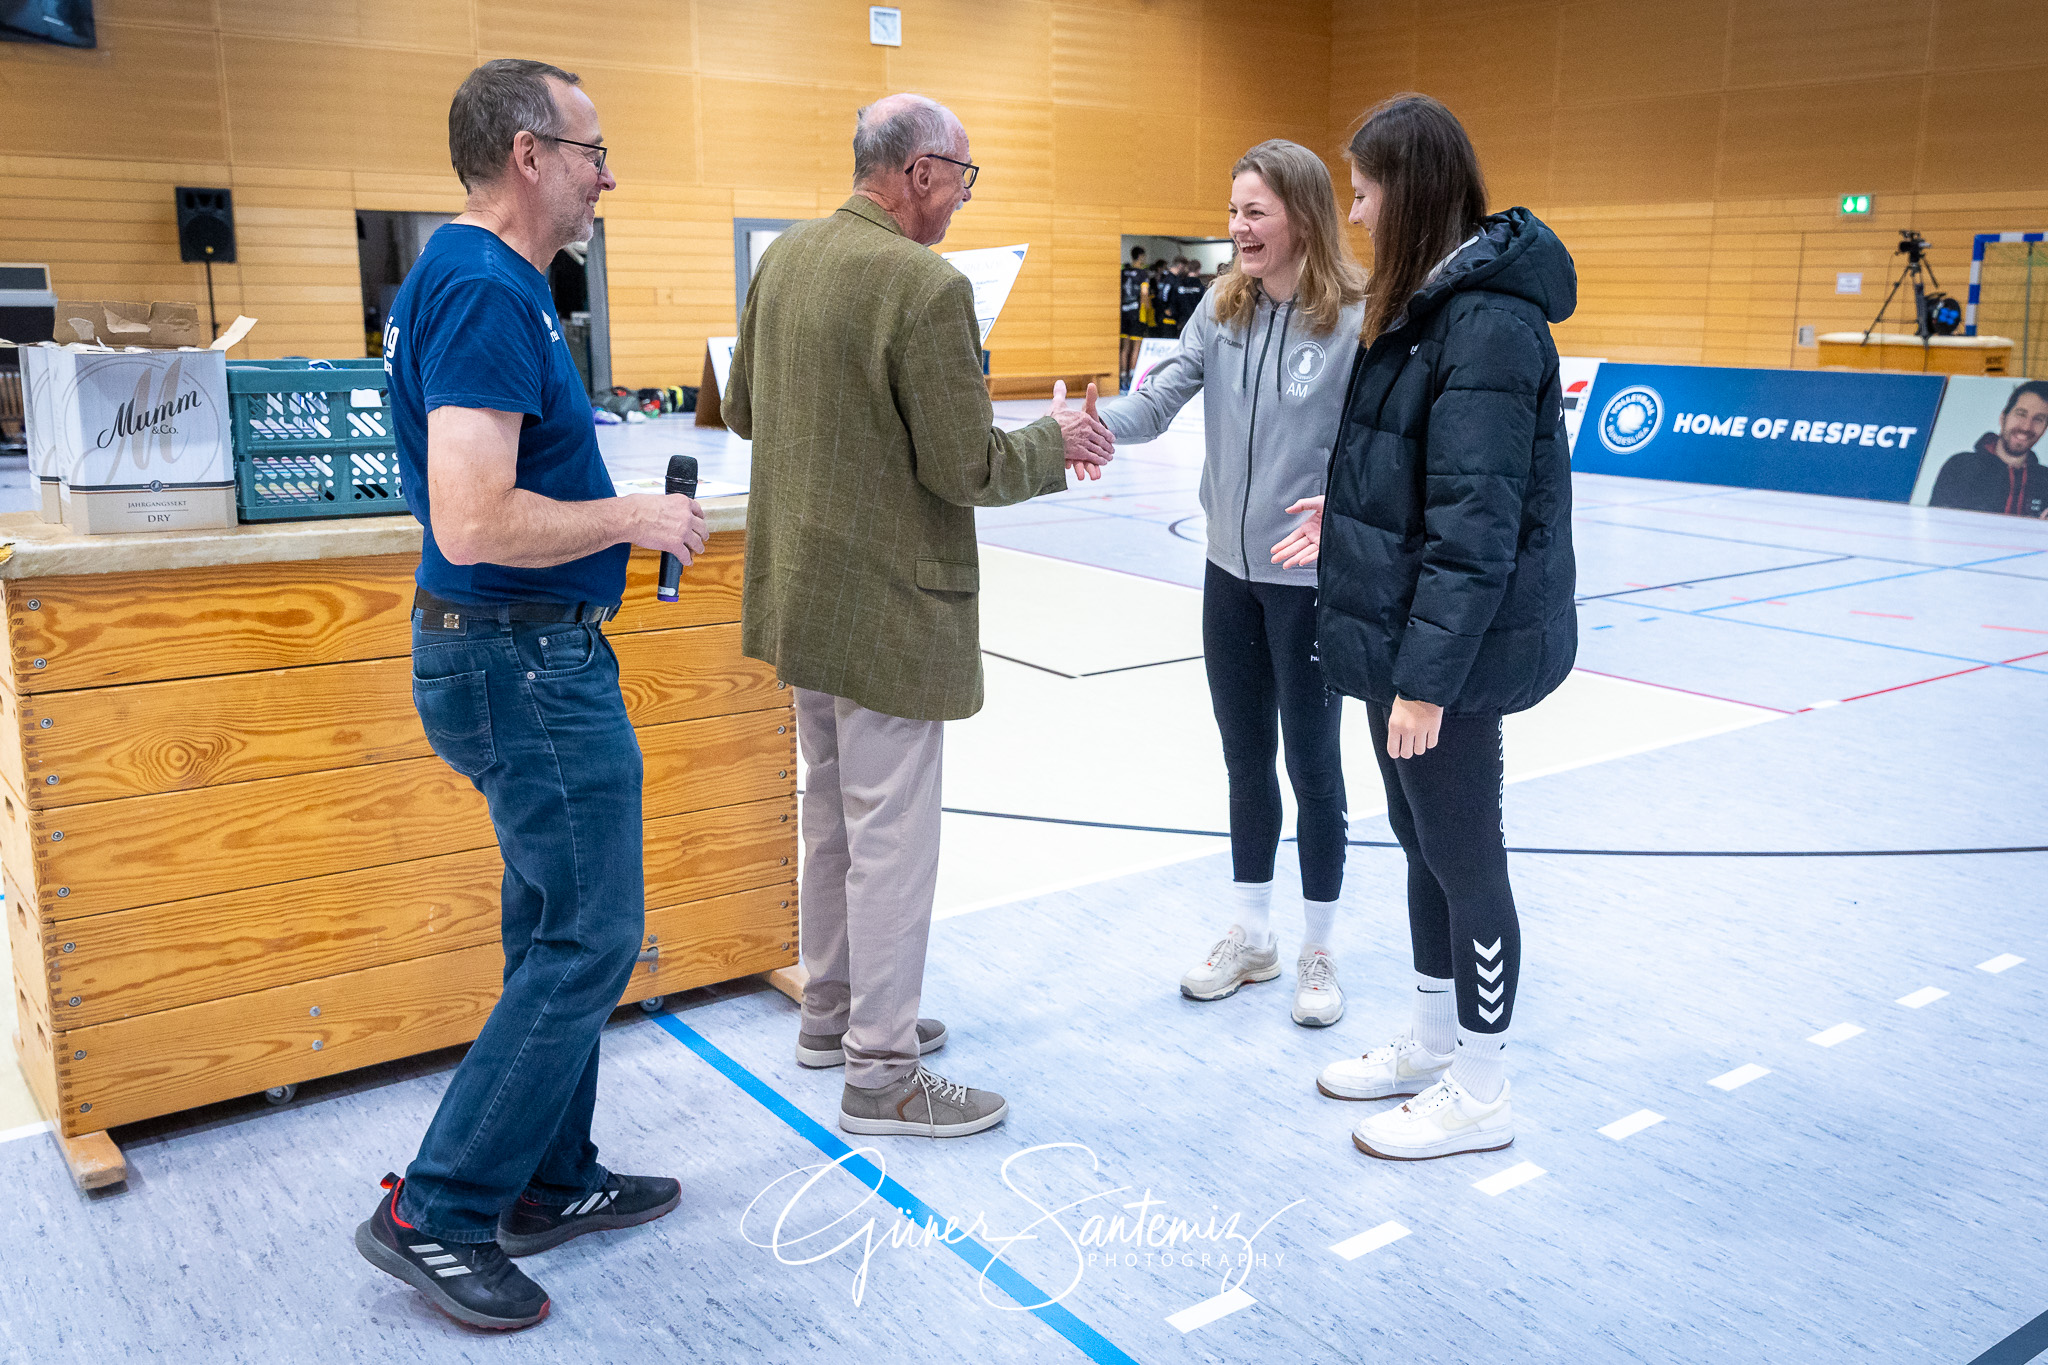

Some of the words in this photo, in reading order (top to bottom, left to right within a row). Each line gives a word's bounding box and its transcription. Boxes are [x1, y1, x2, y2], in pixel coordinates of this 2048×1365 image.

[1286, 382, 1309, 398] AM
[1610, 393, 1656, 417] VOLLEYBALL
[97, 390, 202, 449] Mumm
[151, 426, 179, 435] &Co.
[1673, 412, 1749, 438] HOME
[1751, 417, 1789, 440] OF
[1790, 420, 1918, 449] RESPECT
[127, 500, 187, 509] JAHRGANGSSEKT
[147, 514, 171, 523] DRY
